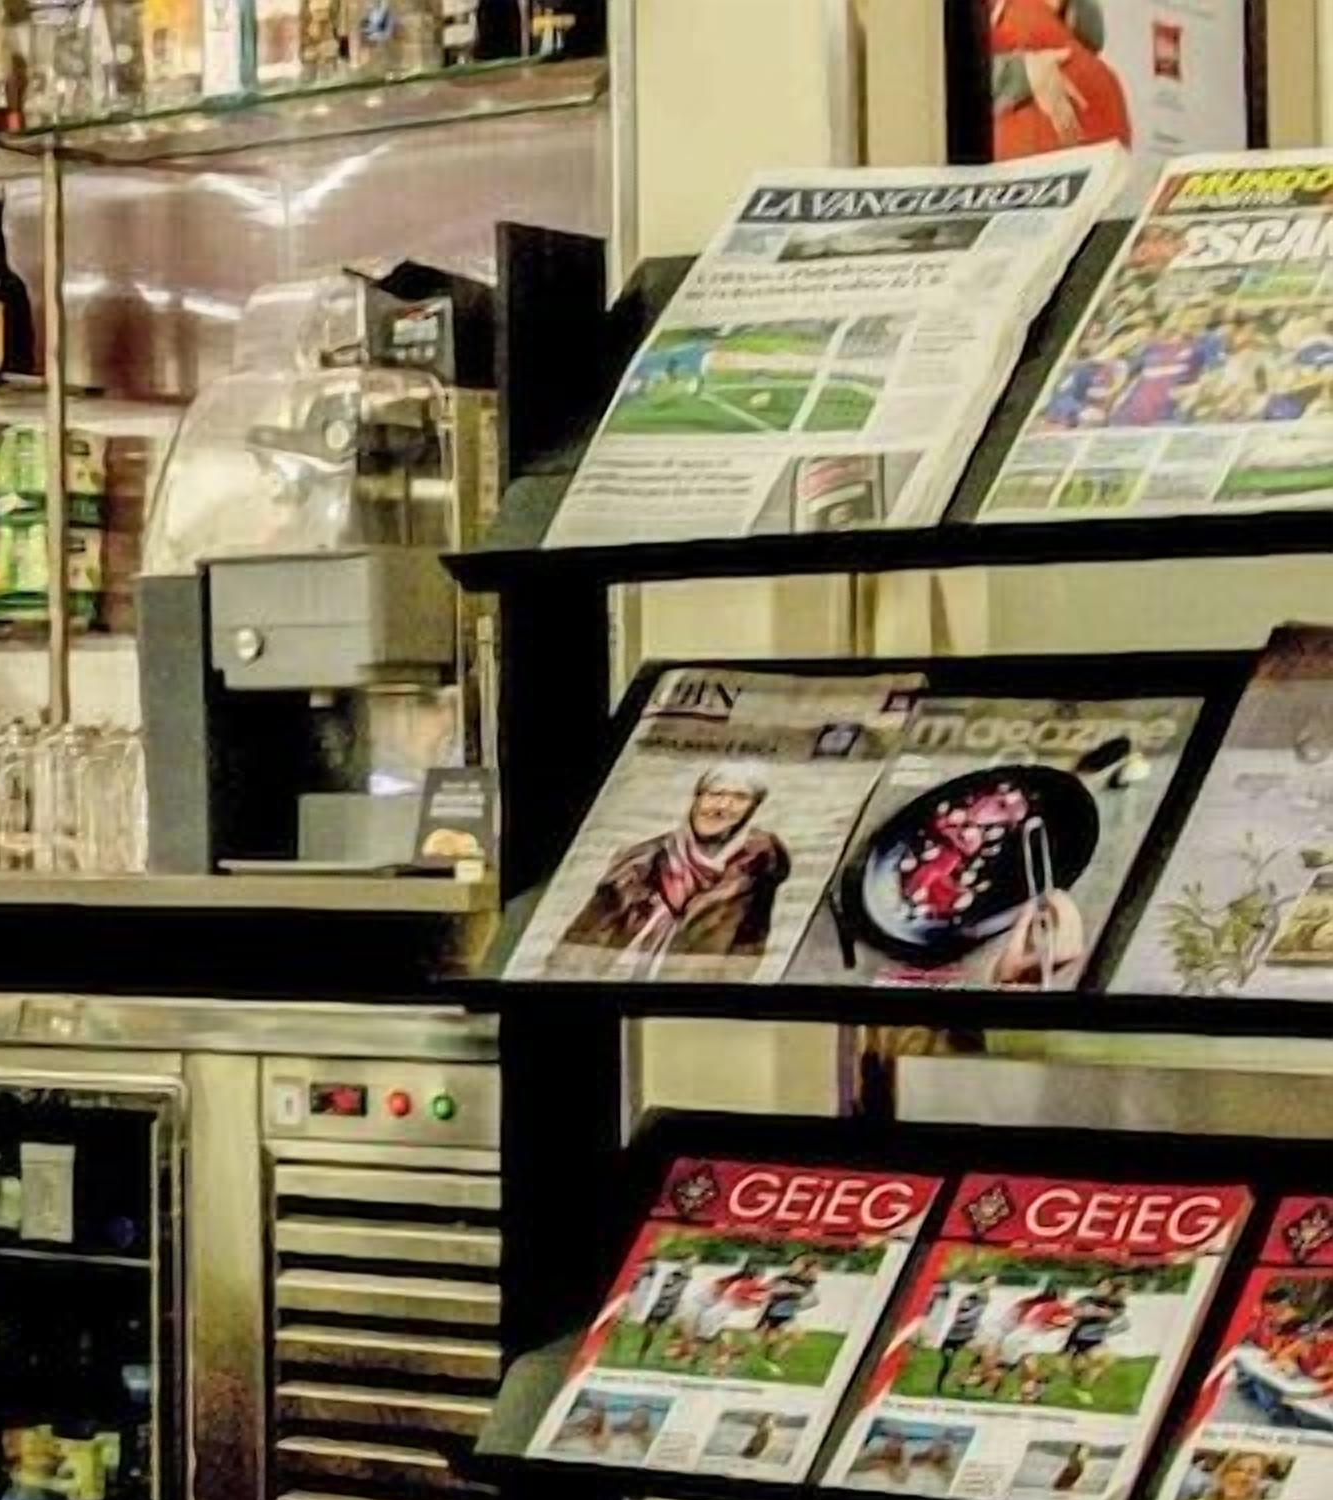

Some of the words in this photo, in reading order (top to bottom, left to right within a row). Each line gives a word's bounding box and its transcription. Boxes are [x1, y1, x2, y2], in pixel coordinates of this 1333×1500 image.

[751, 190, 801, 217] LA
[808, 176, 1071, 217] VANGUARDIA
[1181, 166, 1333, 197] MUNDO
